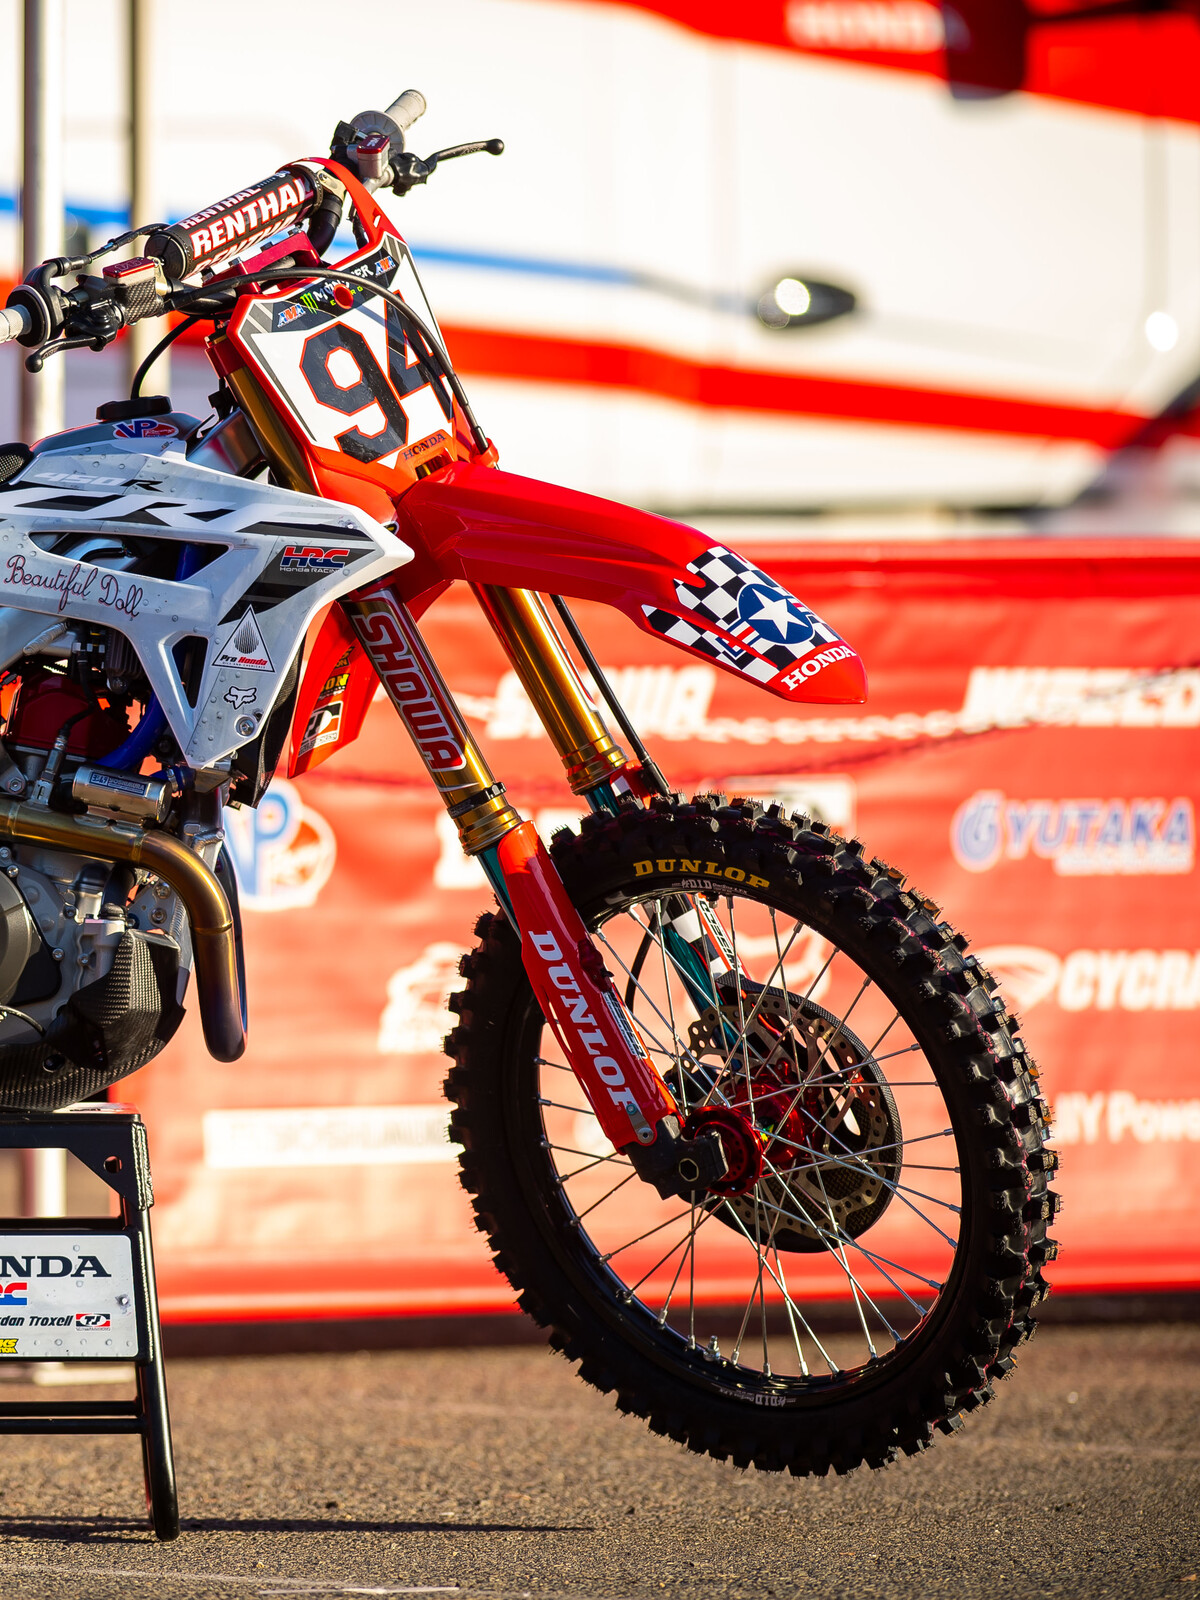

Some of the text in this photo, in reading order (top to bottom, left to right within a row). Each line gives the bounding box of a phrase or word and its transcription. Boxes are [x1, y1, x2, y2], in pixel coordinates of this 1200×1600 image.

[189, 178, 314, 260] RENTHAL
[374, 256, 397, 276] AMA
[277, 303, 307, 328] AMA
[300, 290, 454, 463] 94
[114, 419, 158, 438] VP
[402, 433, 446, 461] HONDA
[280, 546, 350, 568] HRC
[4, 555, 98, 614] Beautiful
[99, 574, 144, 621] Doll
[238, 657, 268, 666] Honda
[780, 643, 857, 690] HONDA
[353, 612, 466, 772] SHOWA
[1007, 802, 1191, 852] YUTAKA
[633, 859, 770, 888] DUNLOP
[527, 930, 638, 1111] DUNLOP
[28, 1315, 74, 1327] Troxell
